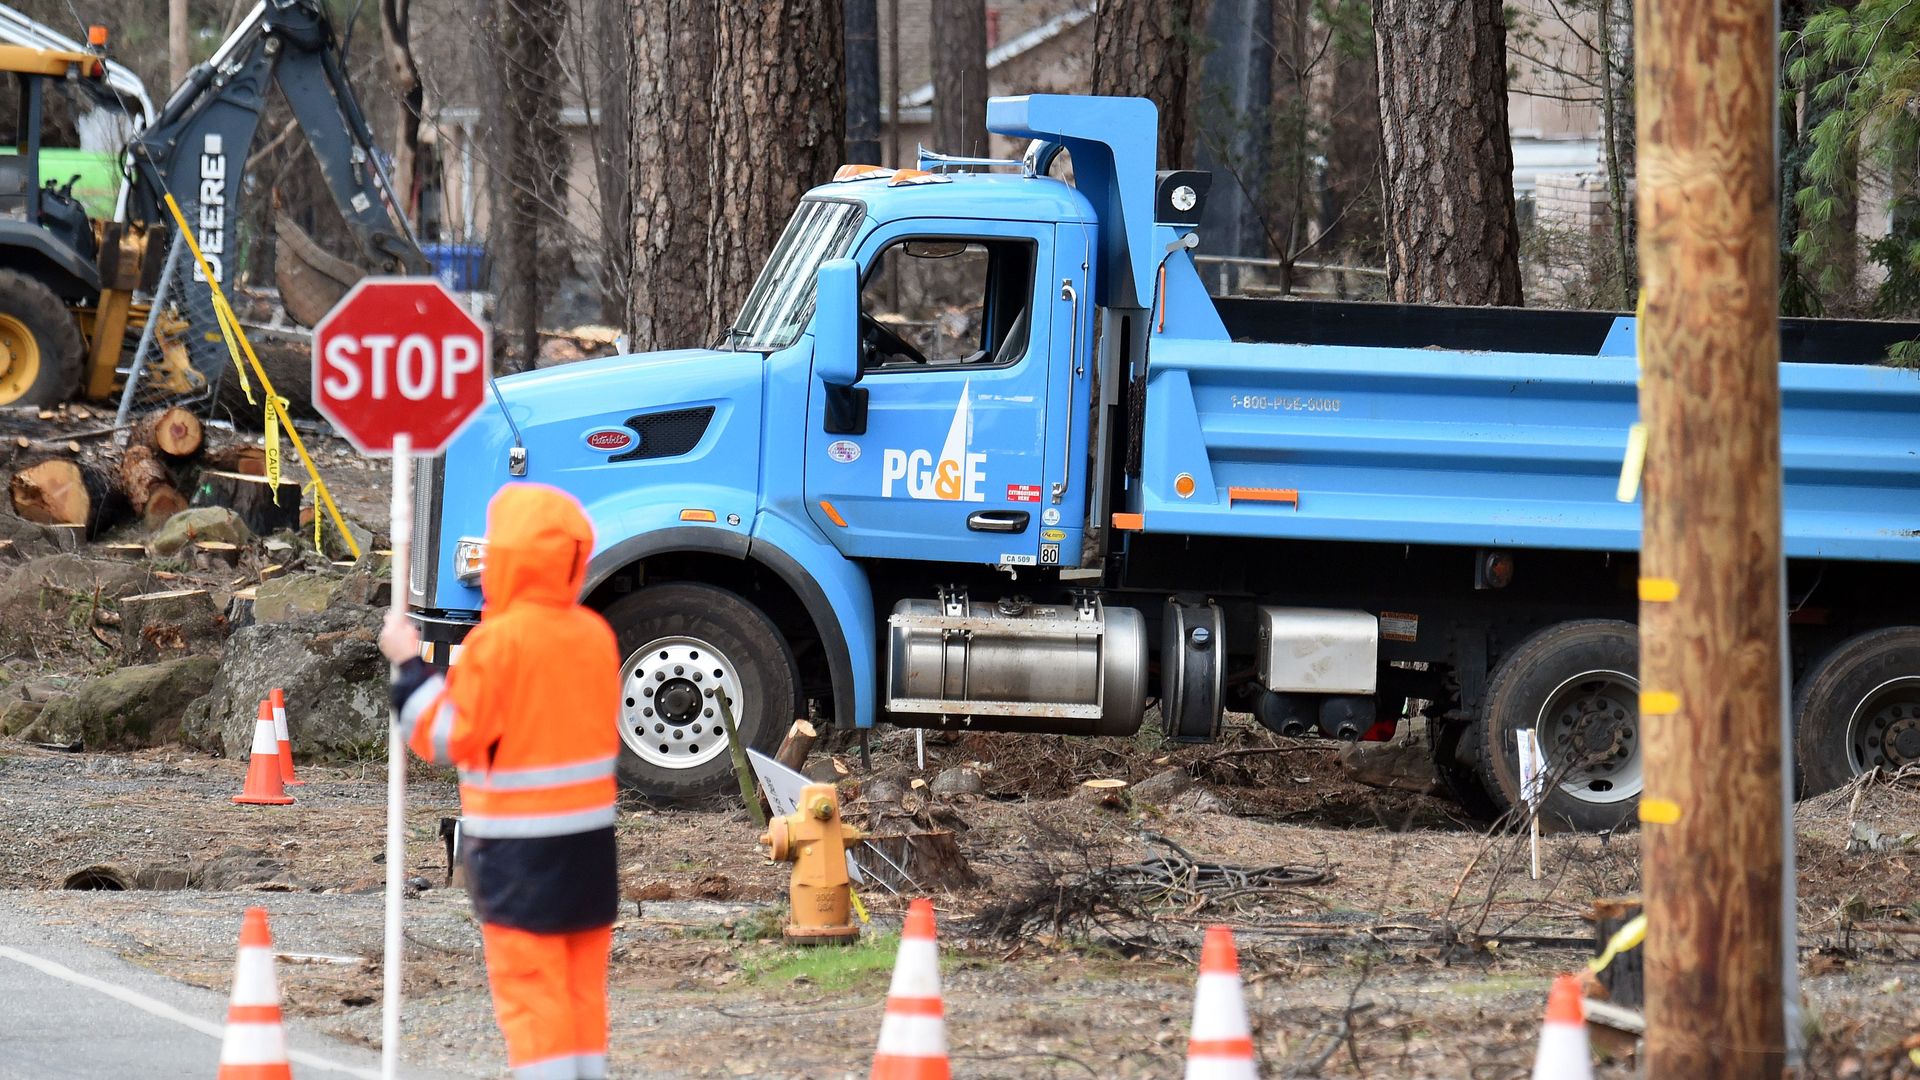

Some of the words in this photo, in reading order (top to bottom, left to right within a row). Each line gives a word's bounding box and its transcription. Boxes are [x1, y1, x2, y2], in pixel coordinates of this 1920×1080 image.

[193, 154, 226, 282] DEERE
[323, 334, 480, 400] STOP
[881, 448, 987, 502] PG&E
[1042, 549, 1057, 563] 80
